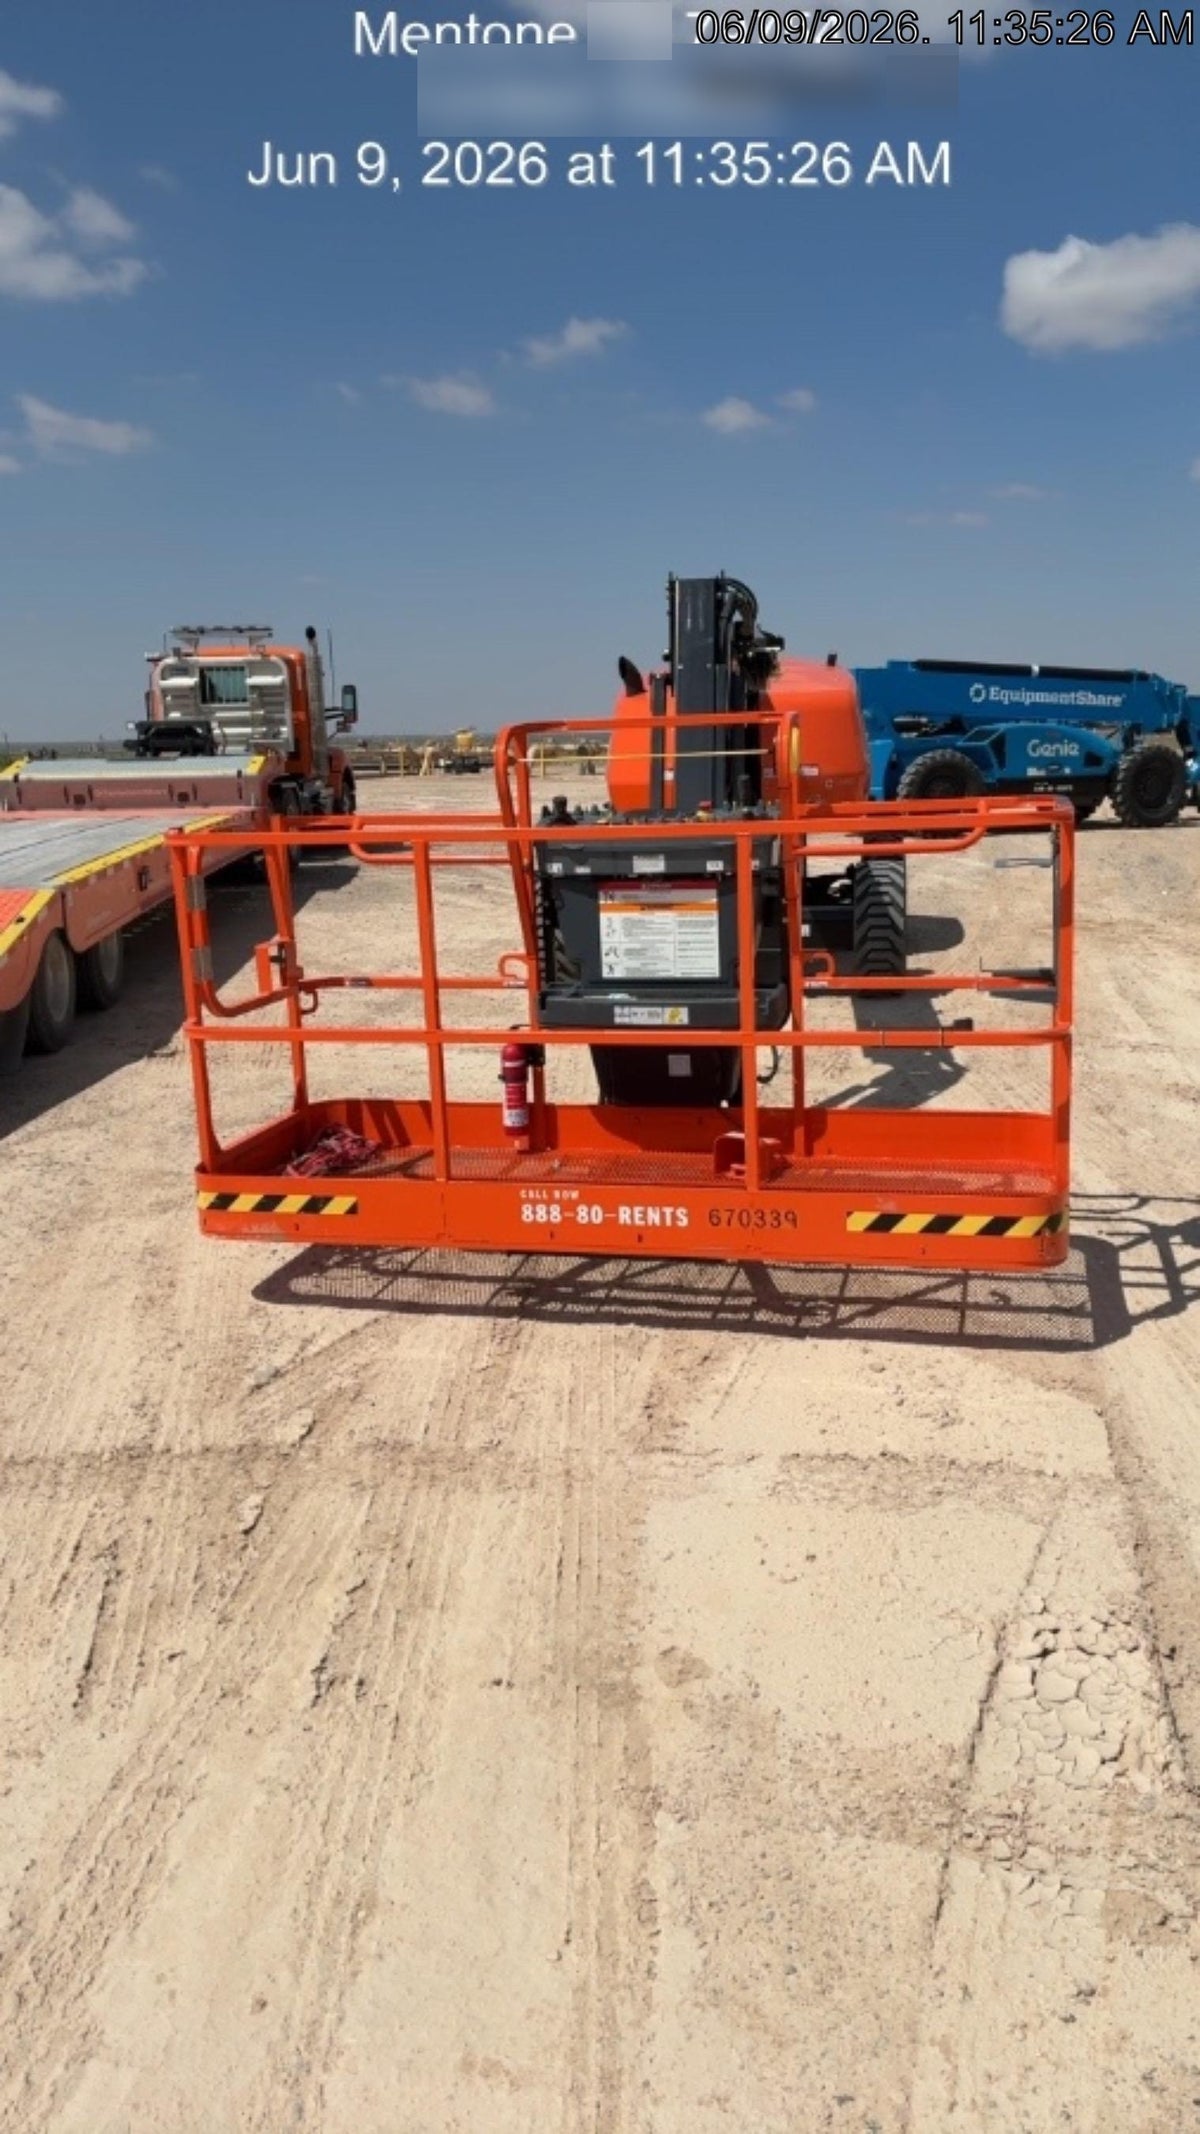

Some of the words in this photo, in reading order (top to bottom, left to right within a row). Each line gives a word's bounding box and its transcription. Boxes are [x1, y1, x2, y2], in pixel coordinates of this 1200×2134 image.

[989, 687, 1123, 707] EquipmentShare
[1027, 739, 1080, 757] Genie
[521, 1204, 689, 1227] 888-80-RENTS
[708, 1208, 798, 1229] 670339
